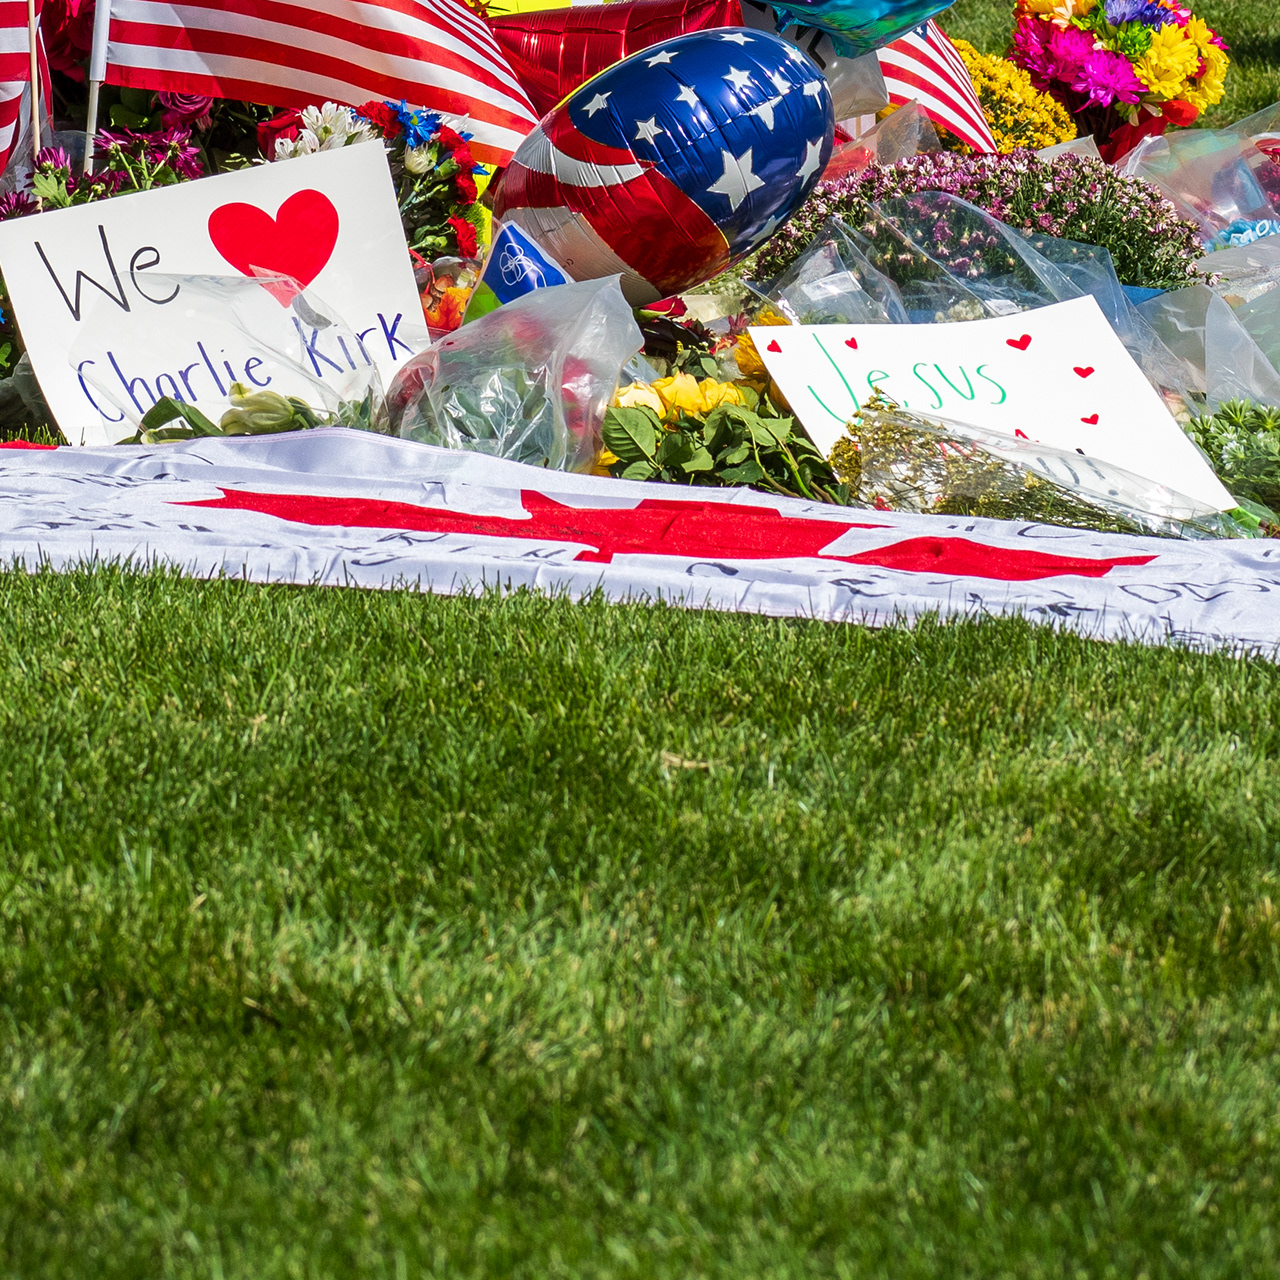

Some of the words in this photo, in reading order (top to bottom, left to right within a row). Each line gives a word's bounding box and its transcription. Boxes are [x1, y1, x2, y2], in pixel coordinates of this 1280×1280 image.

[33, 224, 181, 322] We
[77, 340, 272, 422] Charlie
[807, 332, 1007, 427] Jesus
